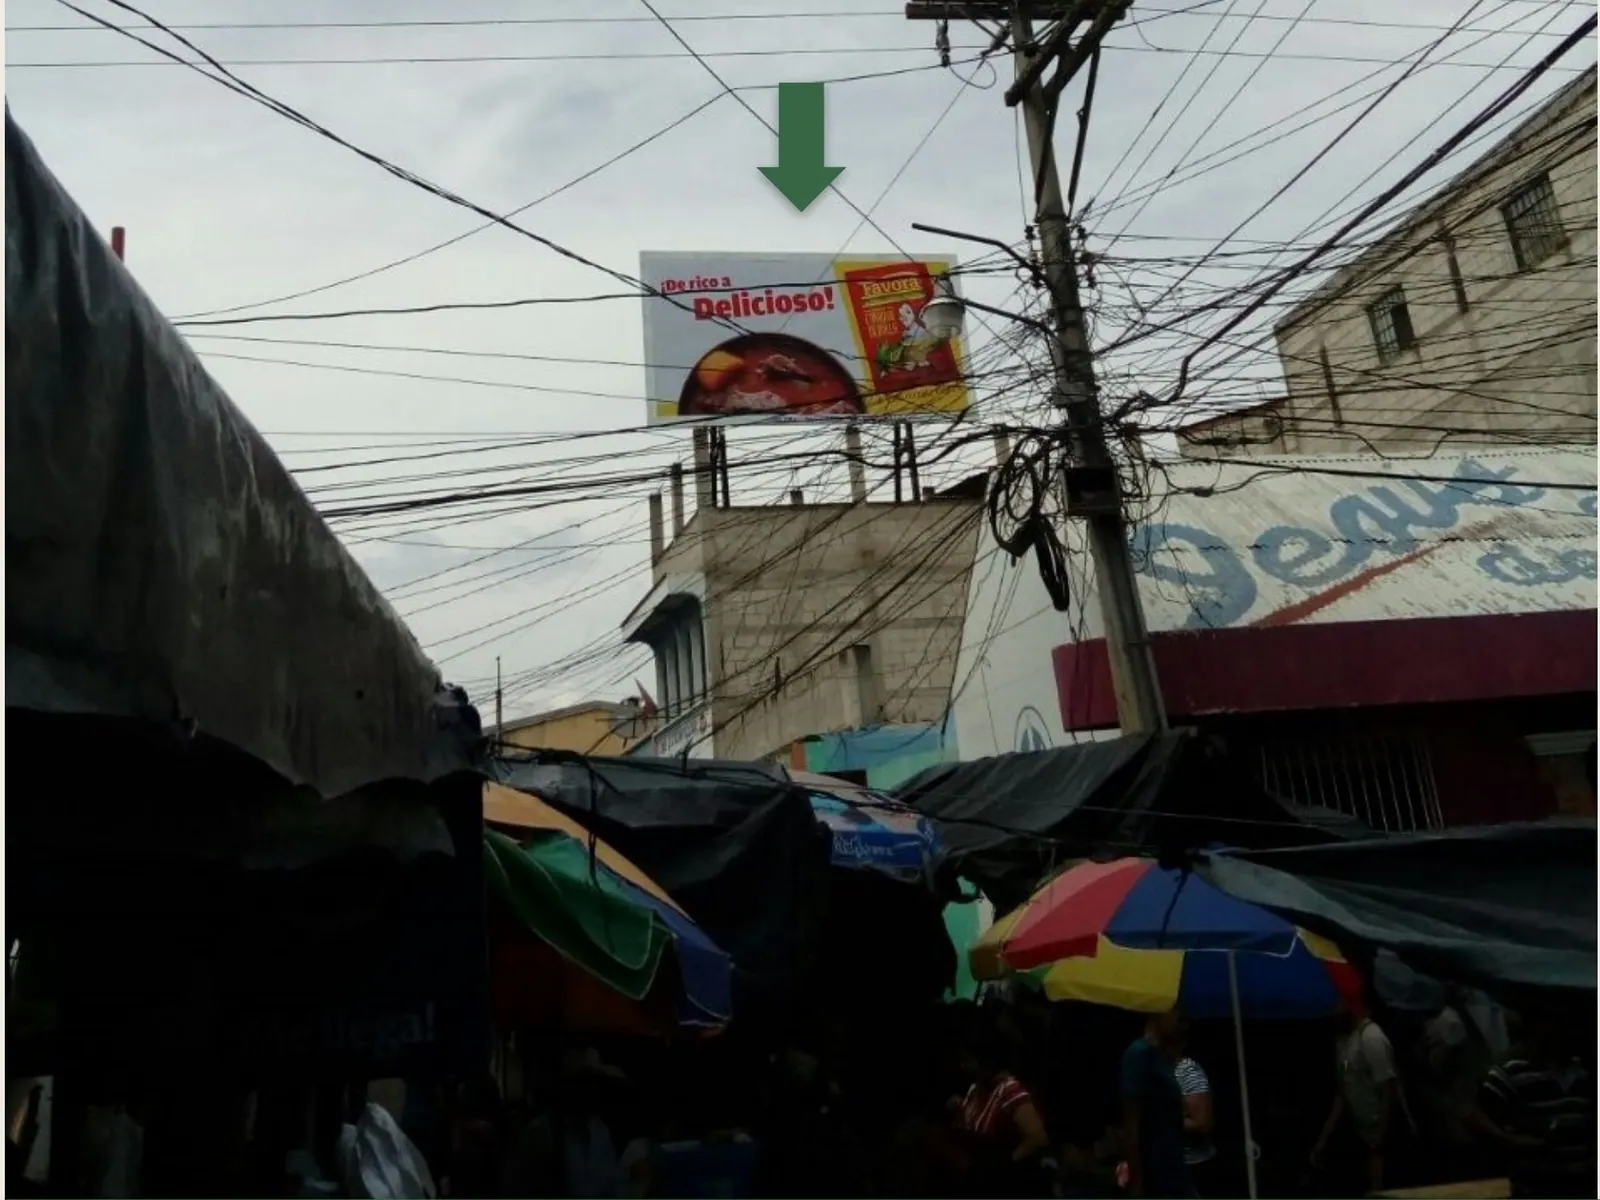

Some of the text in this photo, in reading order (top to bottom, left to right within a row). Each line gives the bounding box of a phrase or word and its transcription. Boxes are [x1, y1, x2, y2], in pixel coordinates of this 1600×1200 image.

[689, 275, 719, 289] rico
[721, 276, 731, 288] a
[694, 286, 835, 320] Delicioso!
